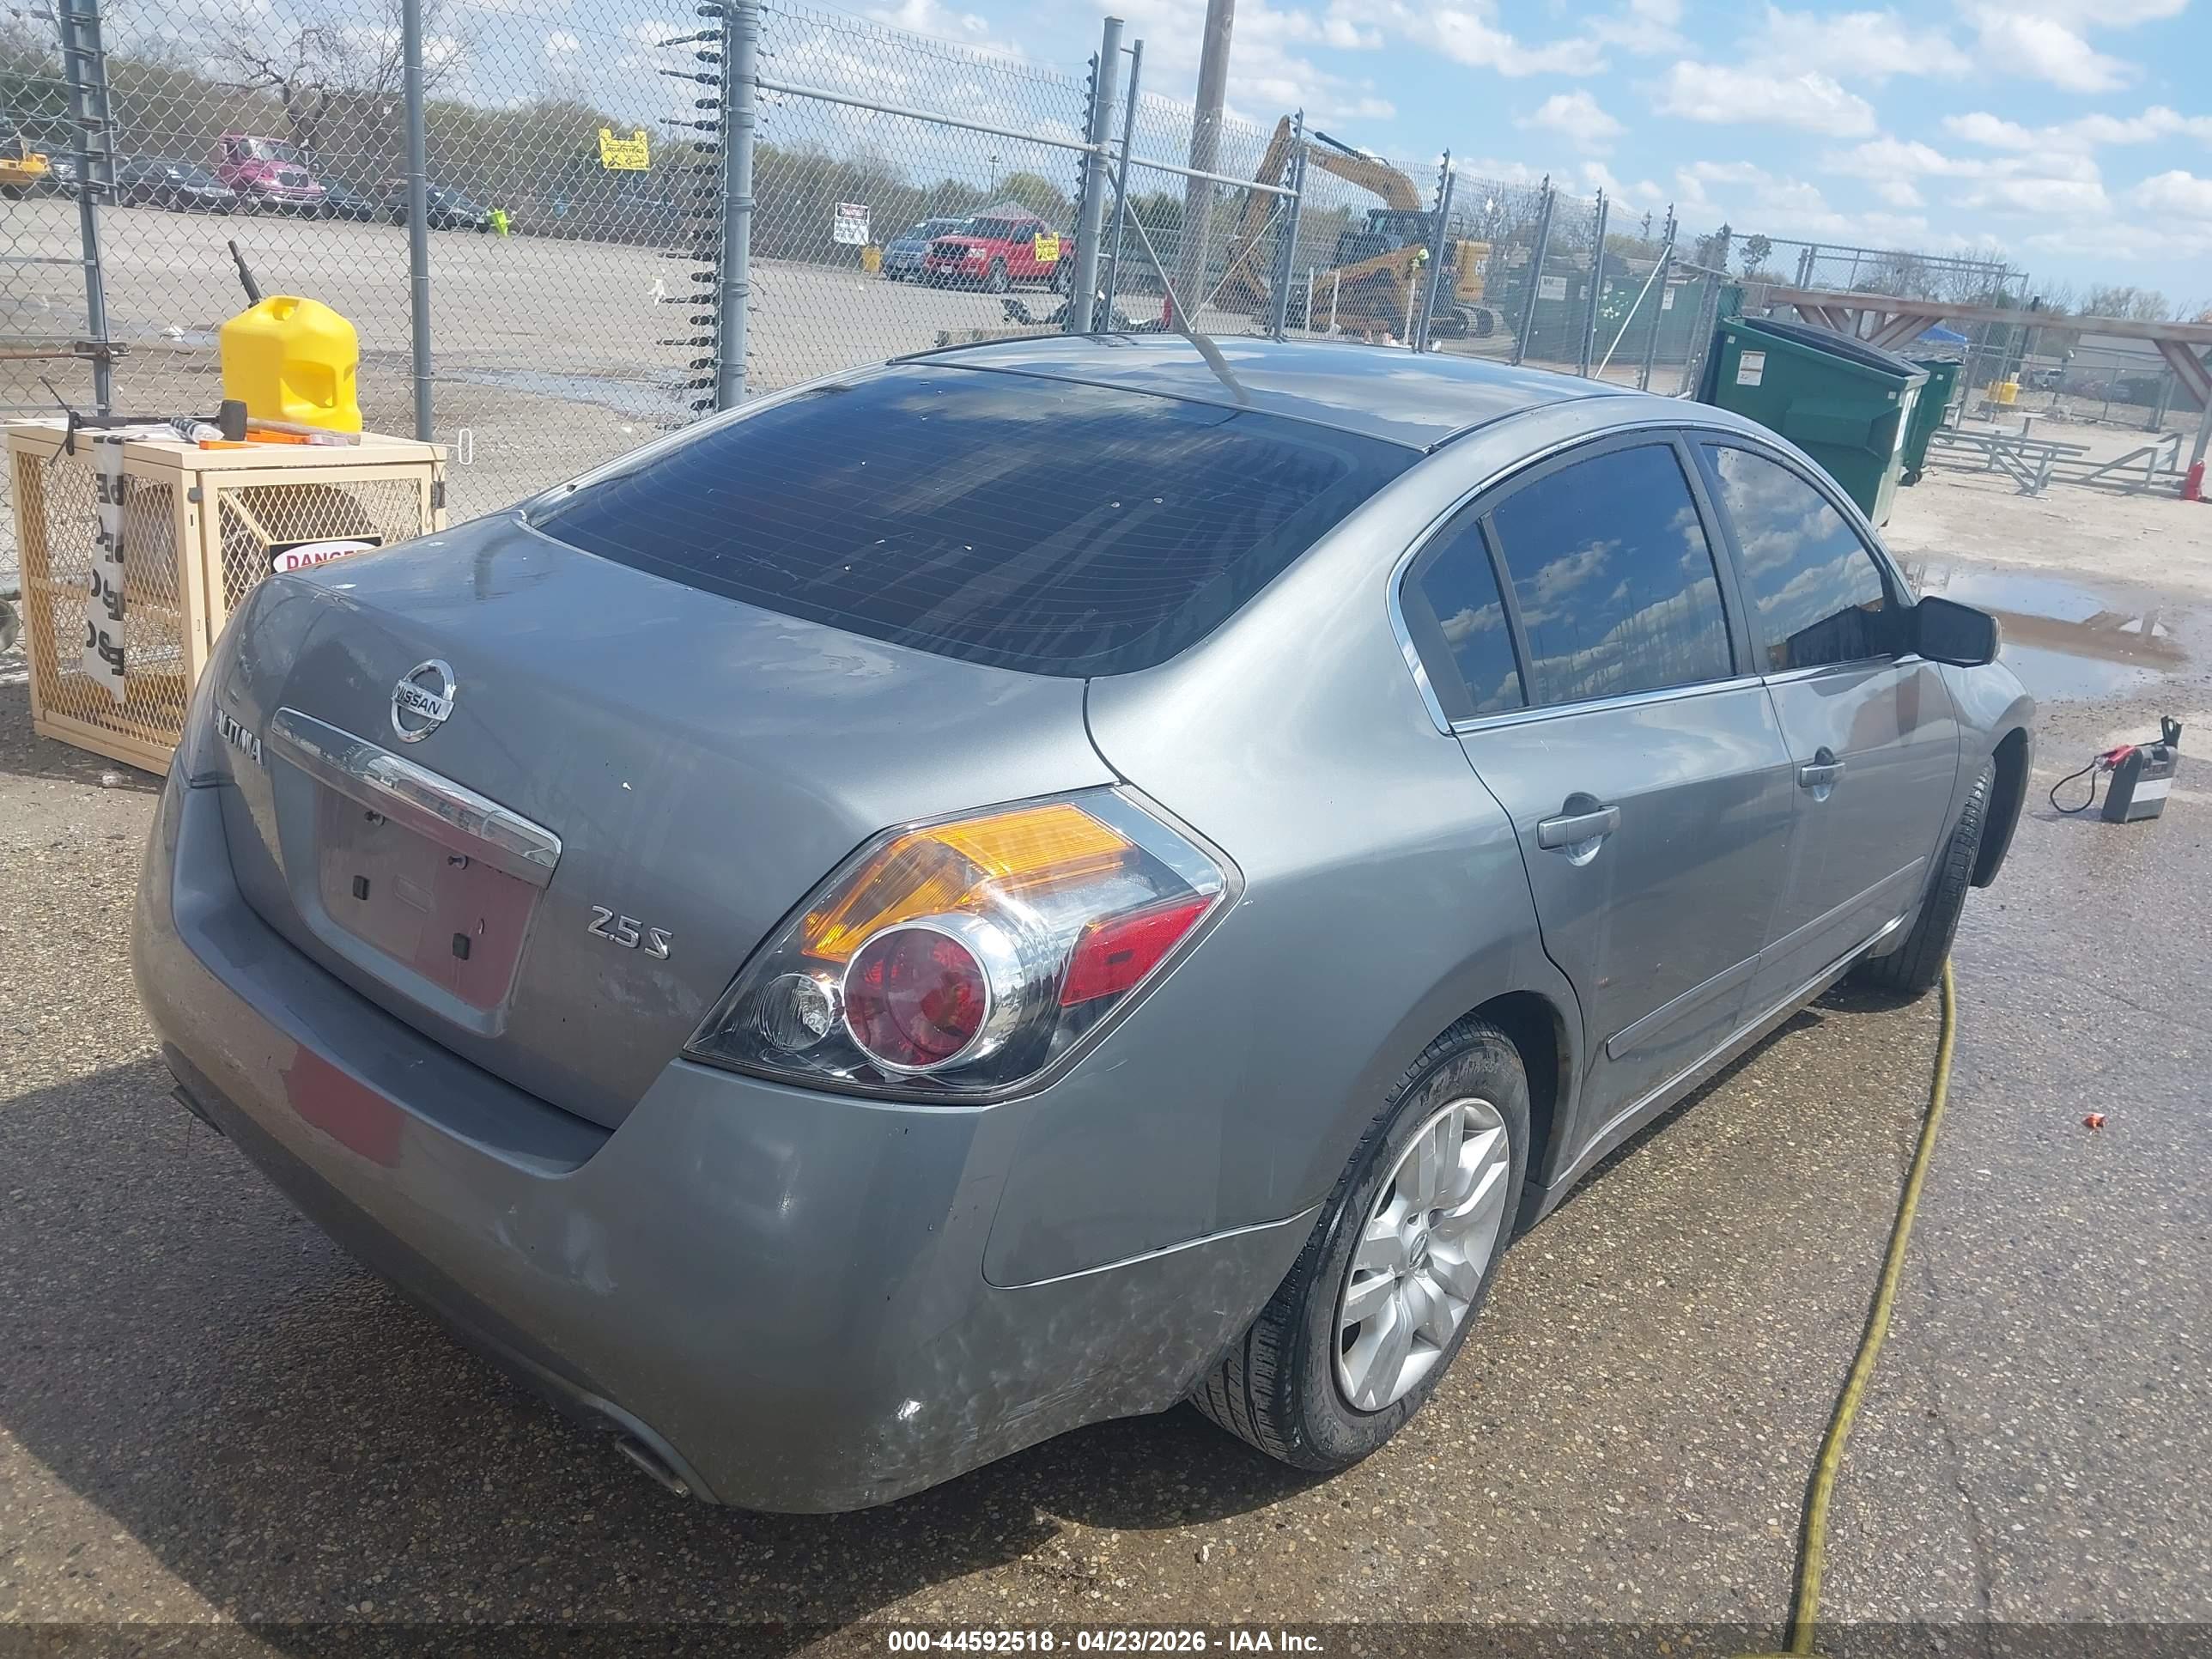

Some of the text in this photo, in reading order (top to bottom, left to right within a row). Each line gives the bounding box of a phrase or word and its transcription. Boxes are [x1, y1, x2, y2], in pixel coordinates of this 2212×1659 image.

[287, 550, 364, 570] DAN
[395, 685, 441, 714] NISSAN
[214, 708, 262, 766] ALTIMA
